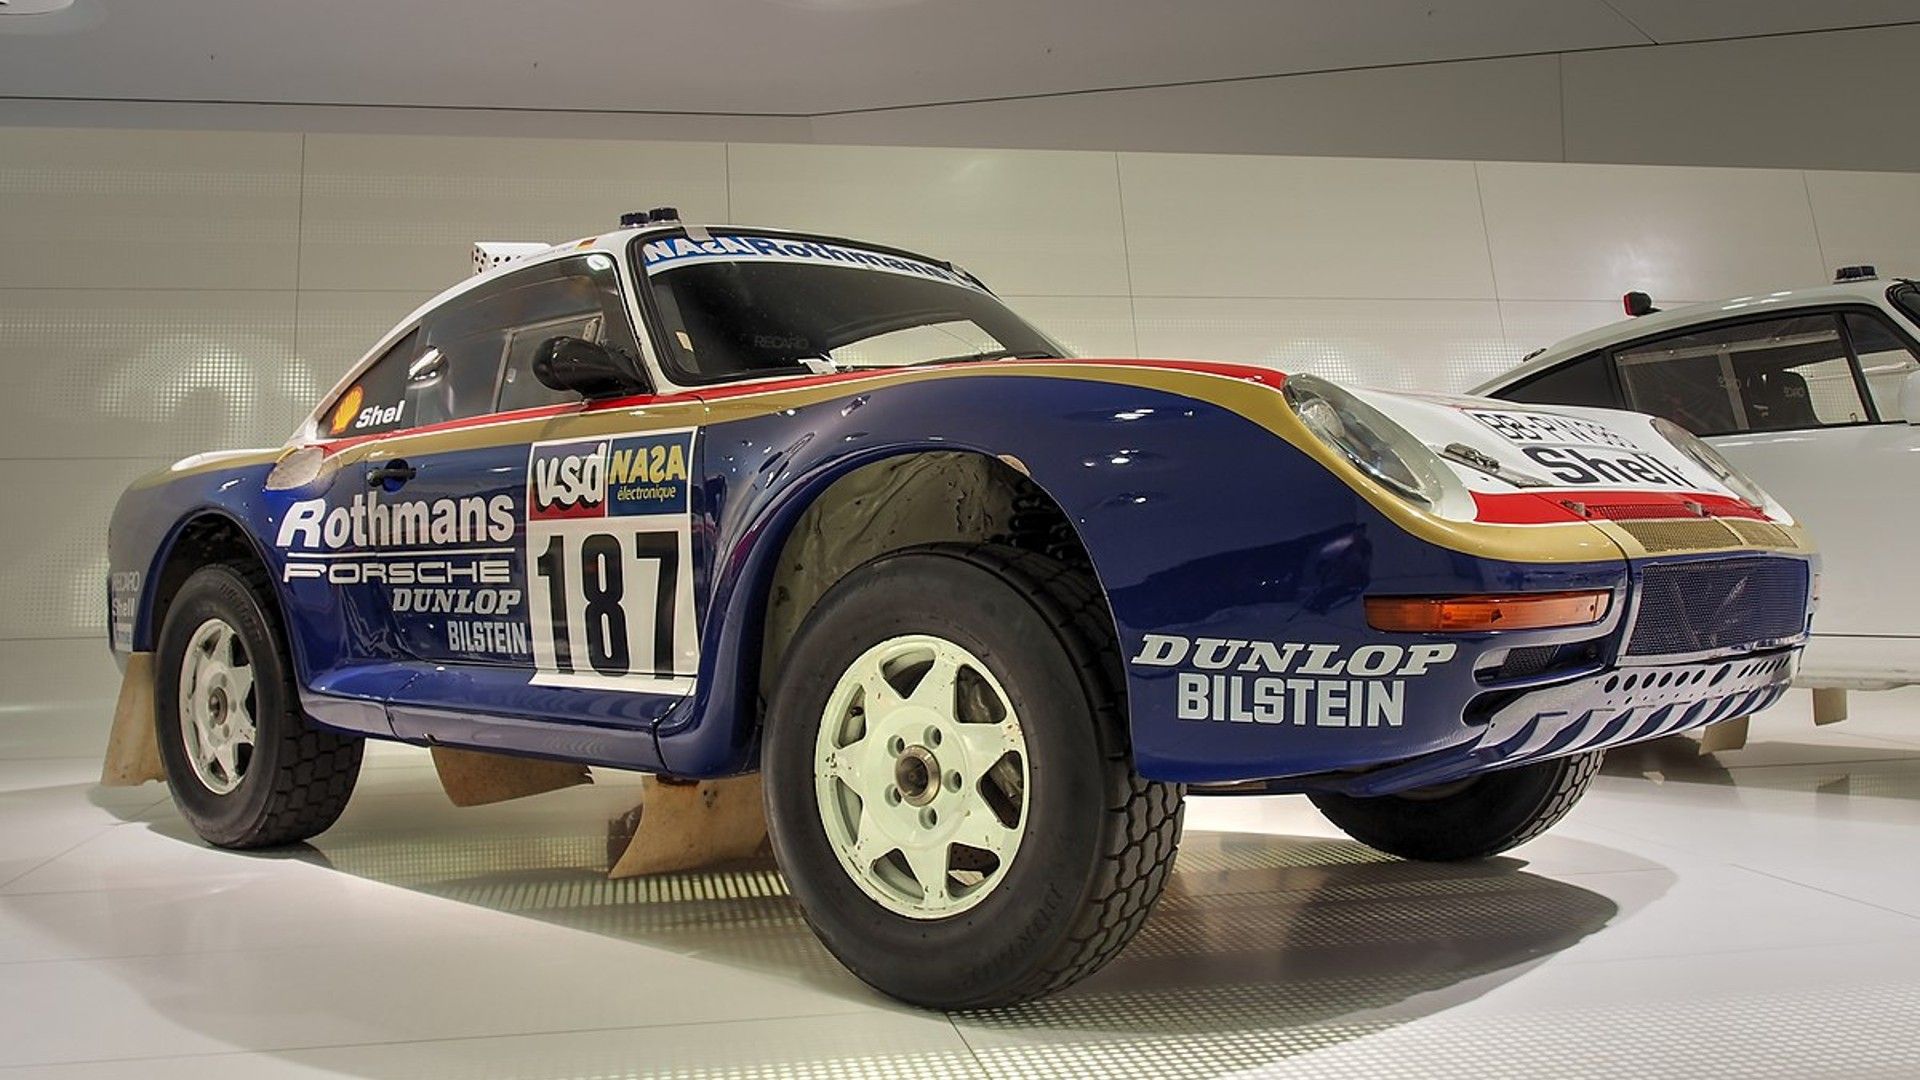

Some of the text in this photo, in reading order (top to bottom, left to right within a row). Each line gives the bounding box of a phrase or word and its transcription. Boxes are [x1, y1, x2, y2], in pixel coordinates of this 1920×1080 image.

[749, 238, 951, 281] Rothmans
[609, 445, 687, 485] NASA
[1521, 446, 1699, 490] Shell
[617, 485, 677, 503] électronique
[276, 490, 516, 549] Rothmans
[282, 560, 512, 584] PORSCHE
[392, 588, 521, 615] DUNLOP
[537, 531, 680, 680] 187
[447, 620, 528, 655] BILSTEIN
[1131, 633, 1458, 676] DUNLOP
[1177, 672, 1406, 728] BILSTEIN
